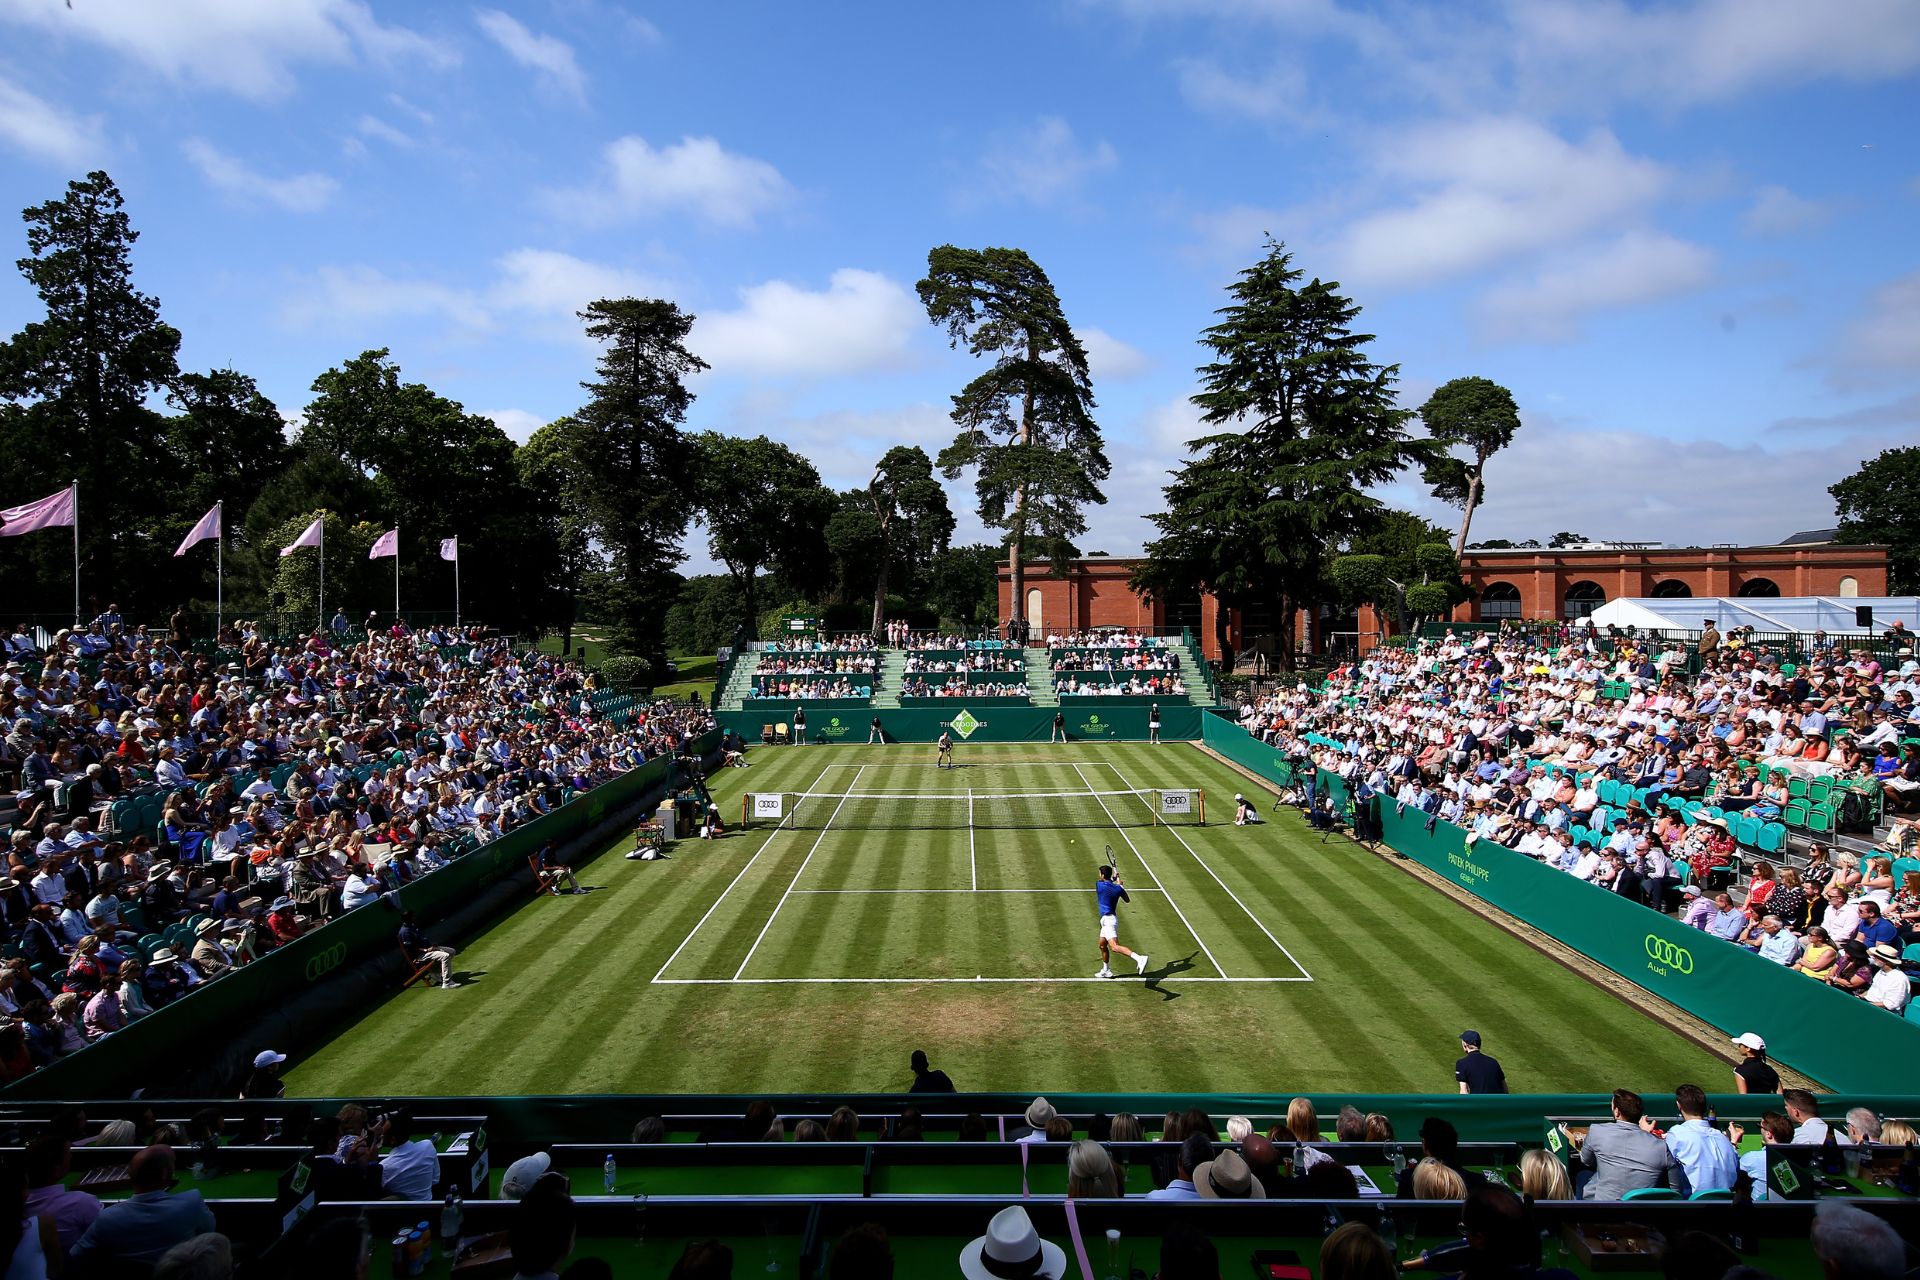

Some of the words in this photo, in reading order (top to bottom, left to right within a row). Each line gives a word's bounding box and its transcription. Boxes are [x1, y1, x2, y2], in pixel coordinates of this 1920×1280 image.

[1447, 852, 1465, 870] PATEK
[1464, 860, 1490, 882] PHILIPPE
[1647, 961, 1667, 977] Audi
